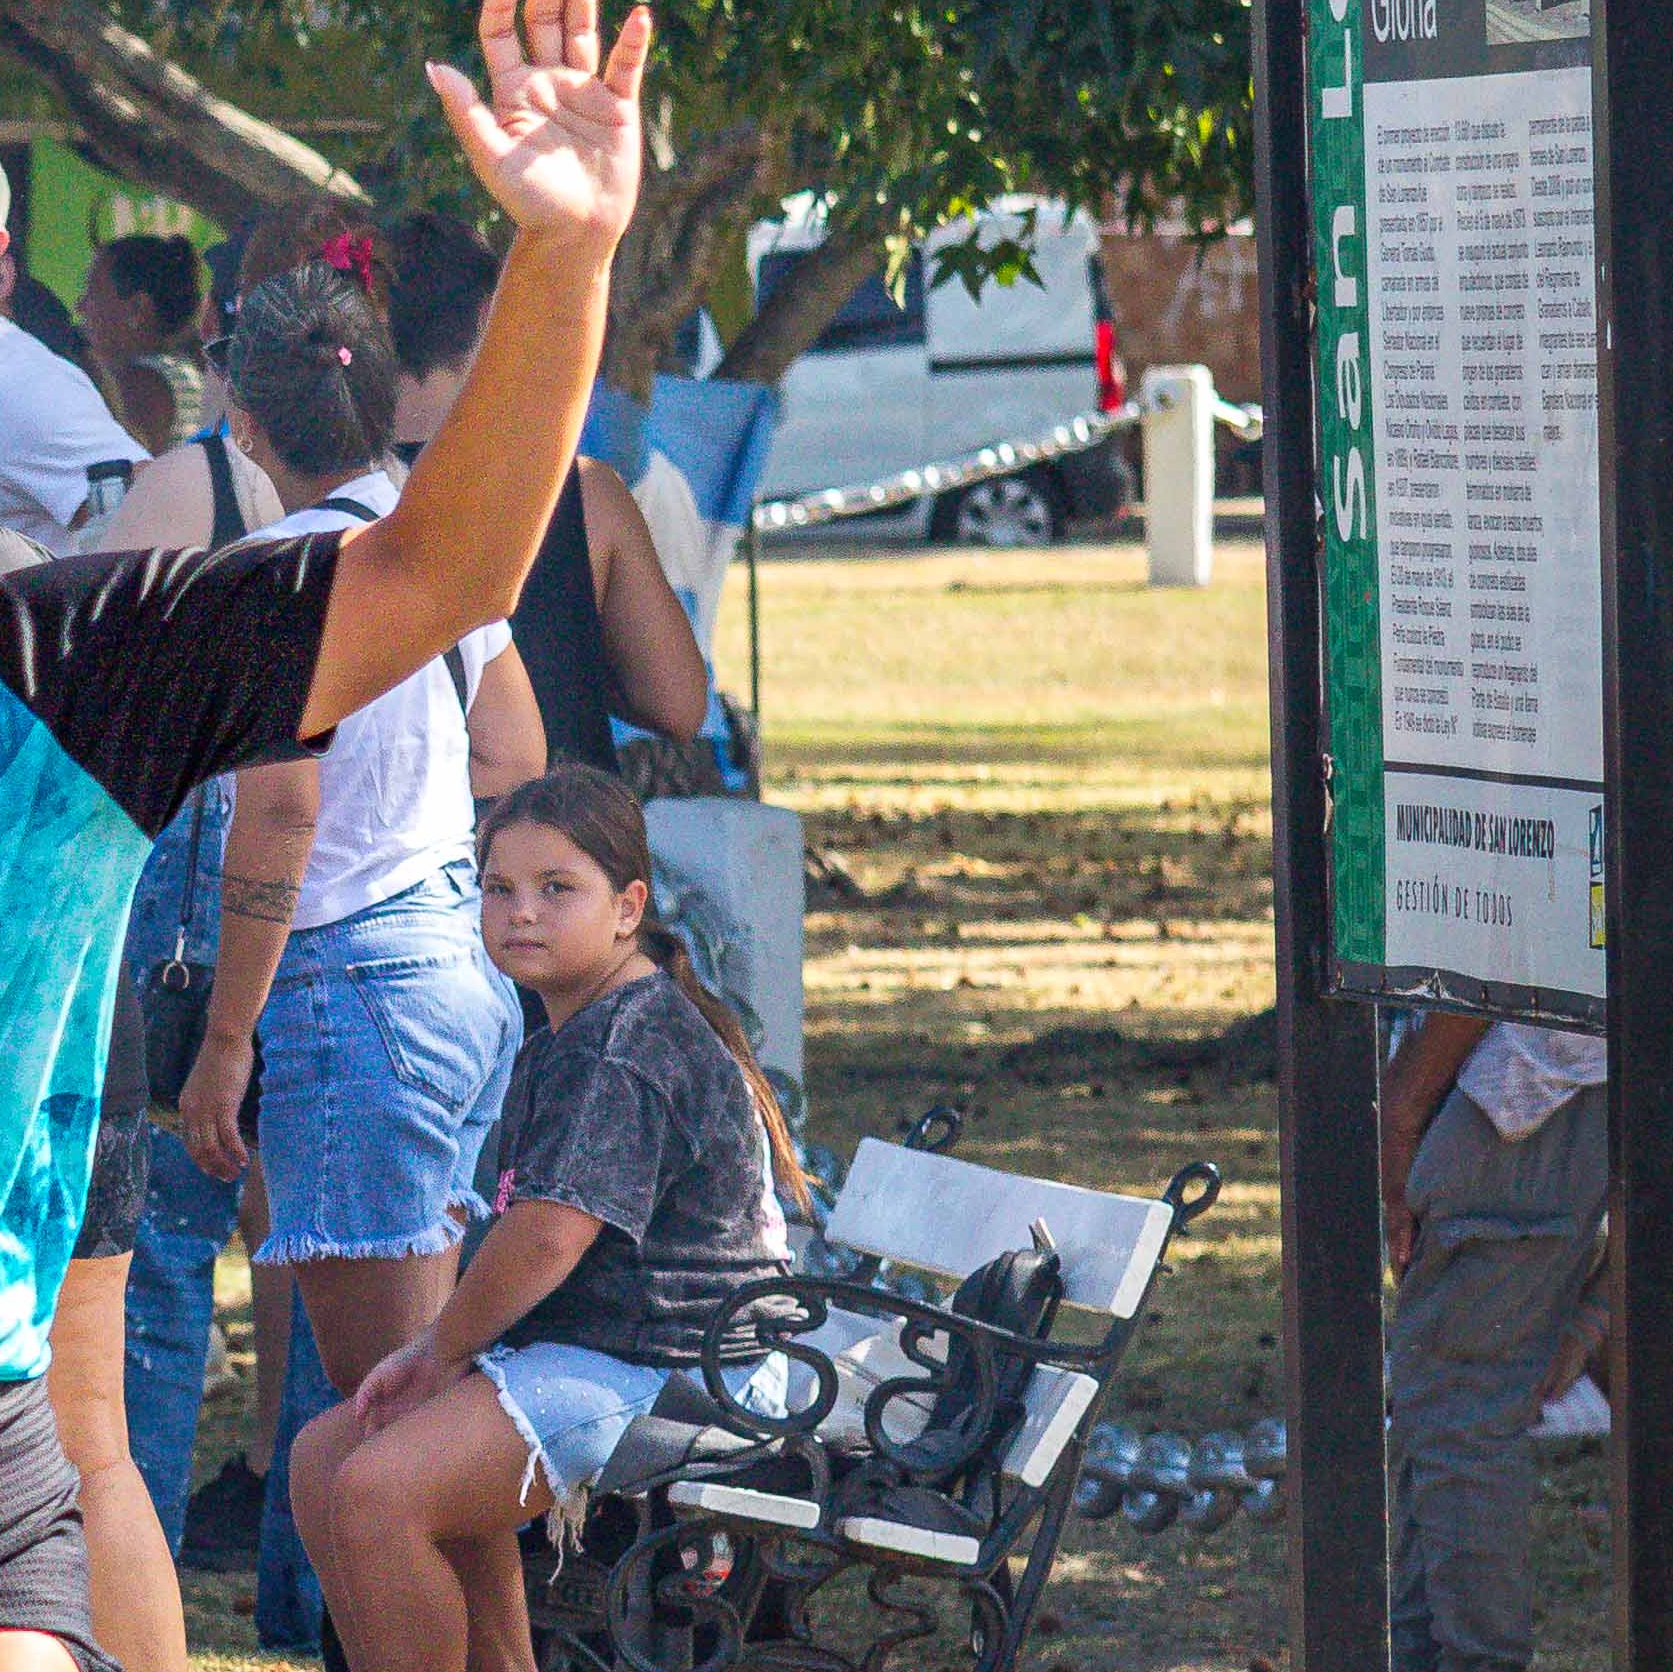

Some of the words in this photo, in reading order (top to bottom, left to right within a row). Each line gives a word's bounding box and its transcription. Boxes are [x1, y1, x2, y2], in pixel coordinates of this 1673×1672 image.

[1331, 204, 1367, 543] San
[1397, 805, 1472, 849] MUNICIPALIDAD
[1475, 813, 1487, 851] DE
[1489, 814, 1506, 854] SAN
[1509, 817, 1555, 860] LORENZO
[1396, 876, 1448, 915] GESTIÓN
[1455, 886, 1468, 919] DE
